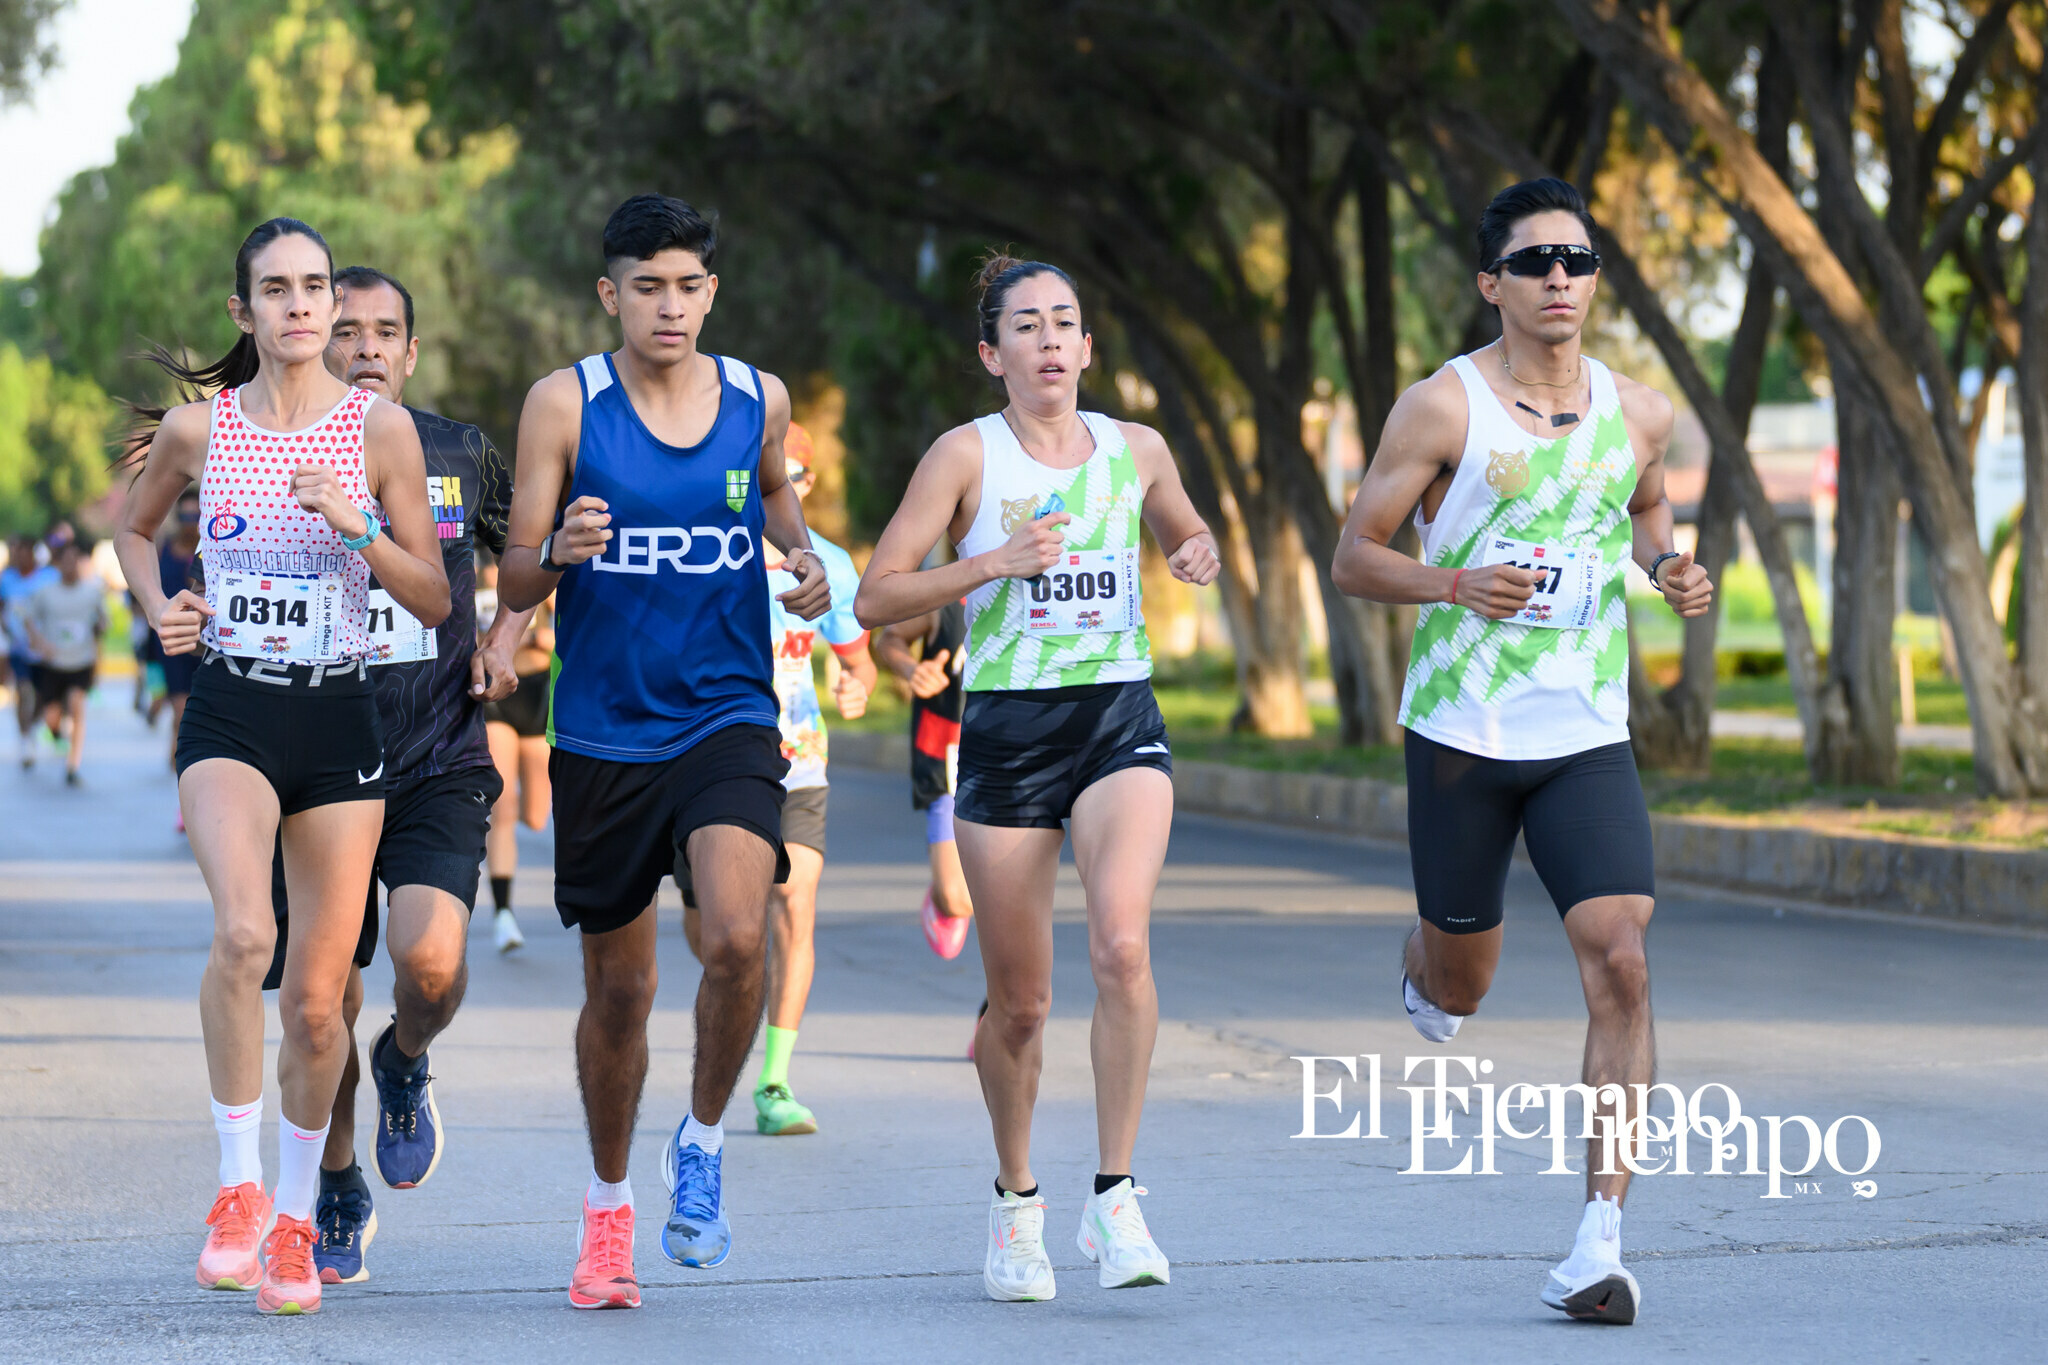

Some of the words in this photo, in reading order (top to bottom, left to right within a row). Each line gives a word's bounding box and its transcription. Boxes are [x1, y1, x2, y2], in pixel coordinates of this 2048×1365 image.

[220, 550, 262, 569] CLUB
[266, 549, 347, 573] ATLÉTICO
[592, 526, 754, 574] LERDO
[1586, 565, 1594, 579] KIT
[1031, 571, 1116, 603] 0309
[1128, 581, 1133, 591] de
[1586, 583, 1593, 592] de
[229, 595, 308, 627] 0314
[324, 596, 332, 609] KIT
[1578, 595, 1592, 626] Entrega
[324, 612, 331, 621] de
[321, 624, 332, 656] Entrega
